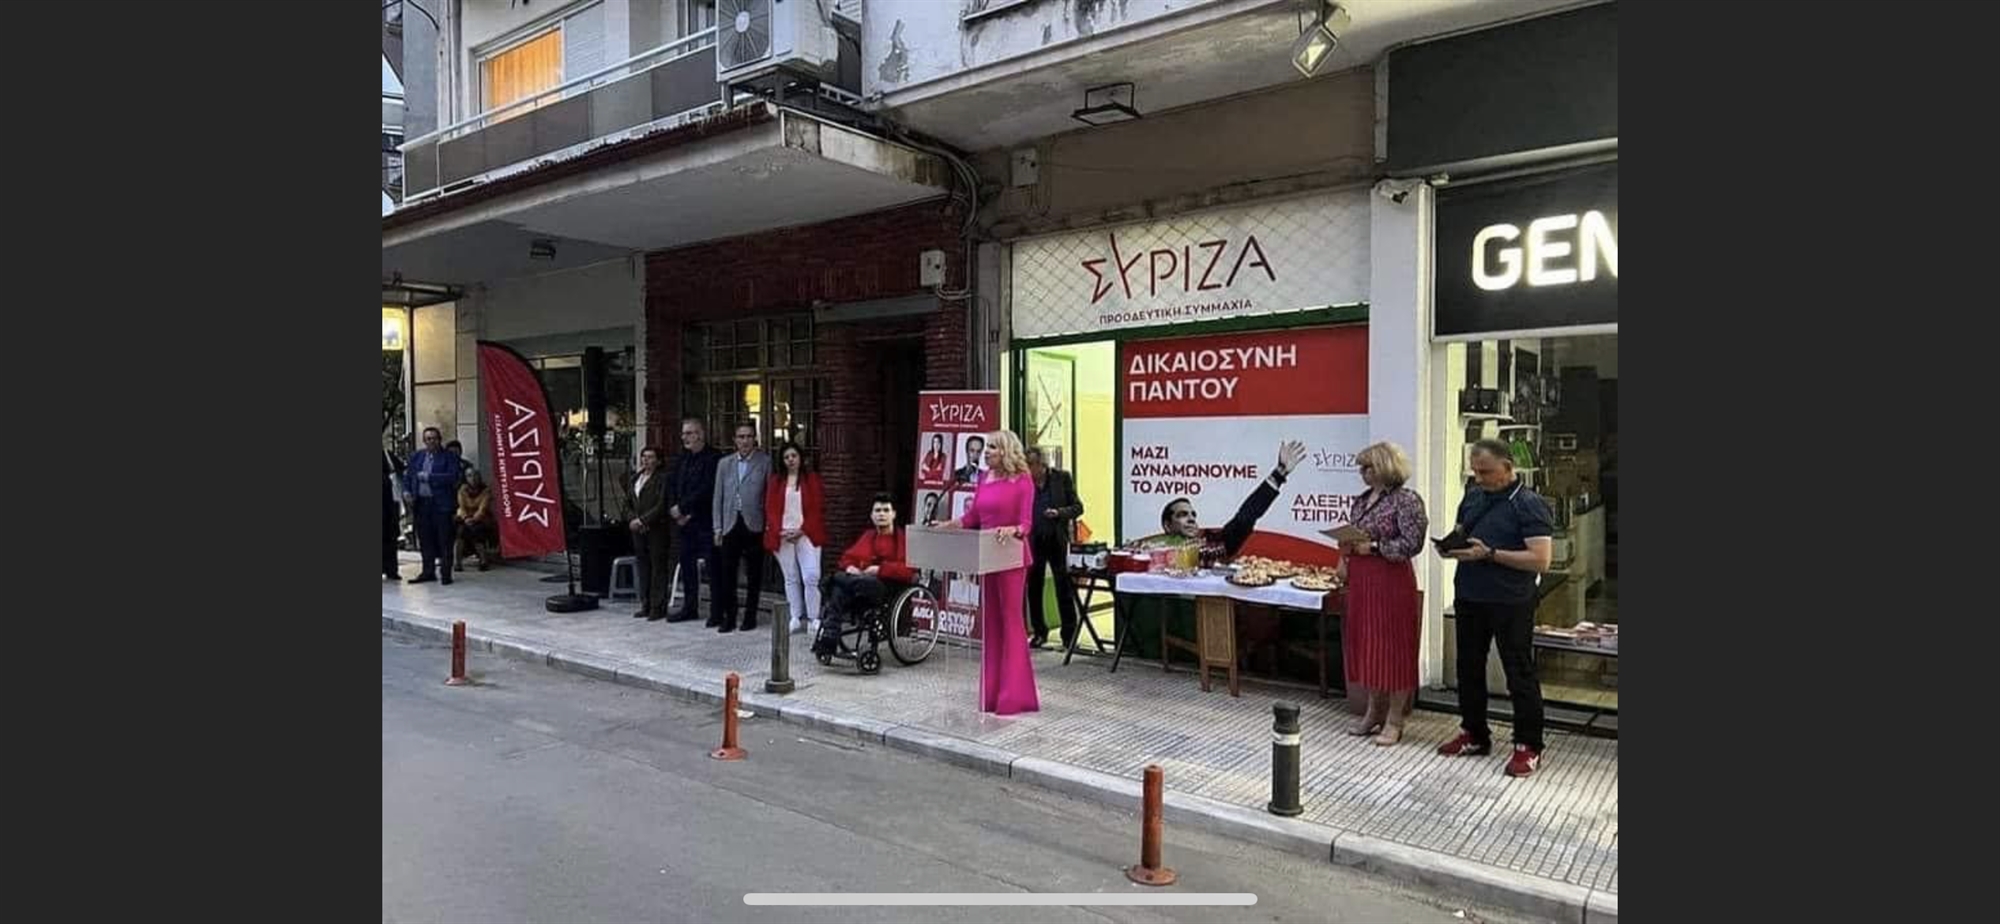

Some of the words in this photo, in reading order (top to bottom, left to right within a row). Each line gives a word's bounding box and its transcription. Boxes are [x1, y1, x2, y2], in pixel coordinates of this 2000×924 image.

[1081, 232, 1276, 304] ΣΥΡΙΖΑ
[1099, 306, 1181, 325] ΠΡΟΟΔΕΥΤΙΚΗ
[1185, 299, 1253, 316] ΣΥΜΜΑΧΙΑ
[1129, 344, 1297, 375] ΔΙΚΑΙΟΣΥΝΗ
[1129, 377, 1239, 402] ΠΑΝΤΟΥ
[929, 397, 985, 422] ΣΥΡΙΖΑ
[1131, 446, 1169, 460] ΜΑΖΙ
[1131, 464, 1258, 479] ΔΥΝΑΜΩΝΟΥΜΕ
[1131, 480, 1152, 494] ΤΟ
[1155, 481, 1201, 495] ΑΥΡΙΟ
[1294, 494, 1357, 508] ΑΛΕΞΗ
[1291, 508, 1351, 523] ΤΣΙΠΡΑ
